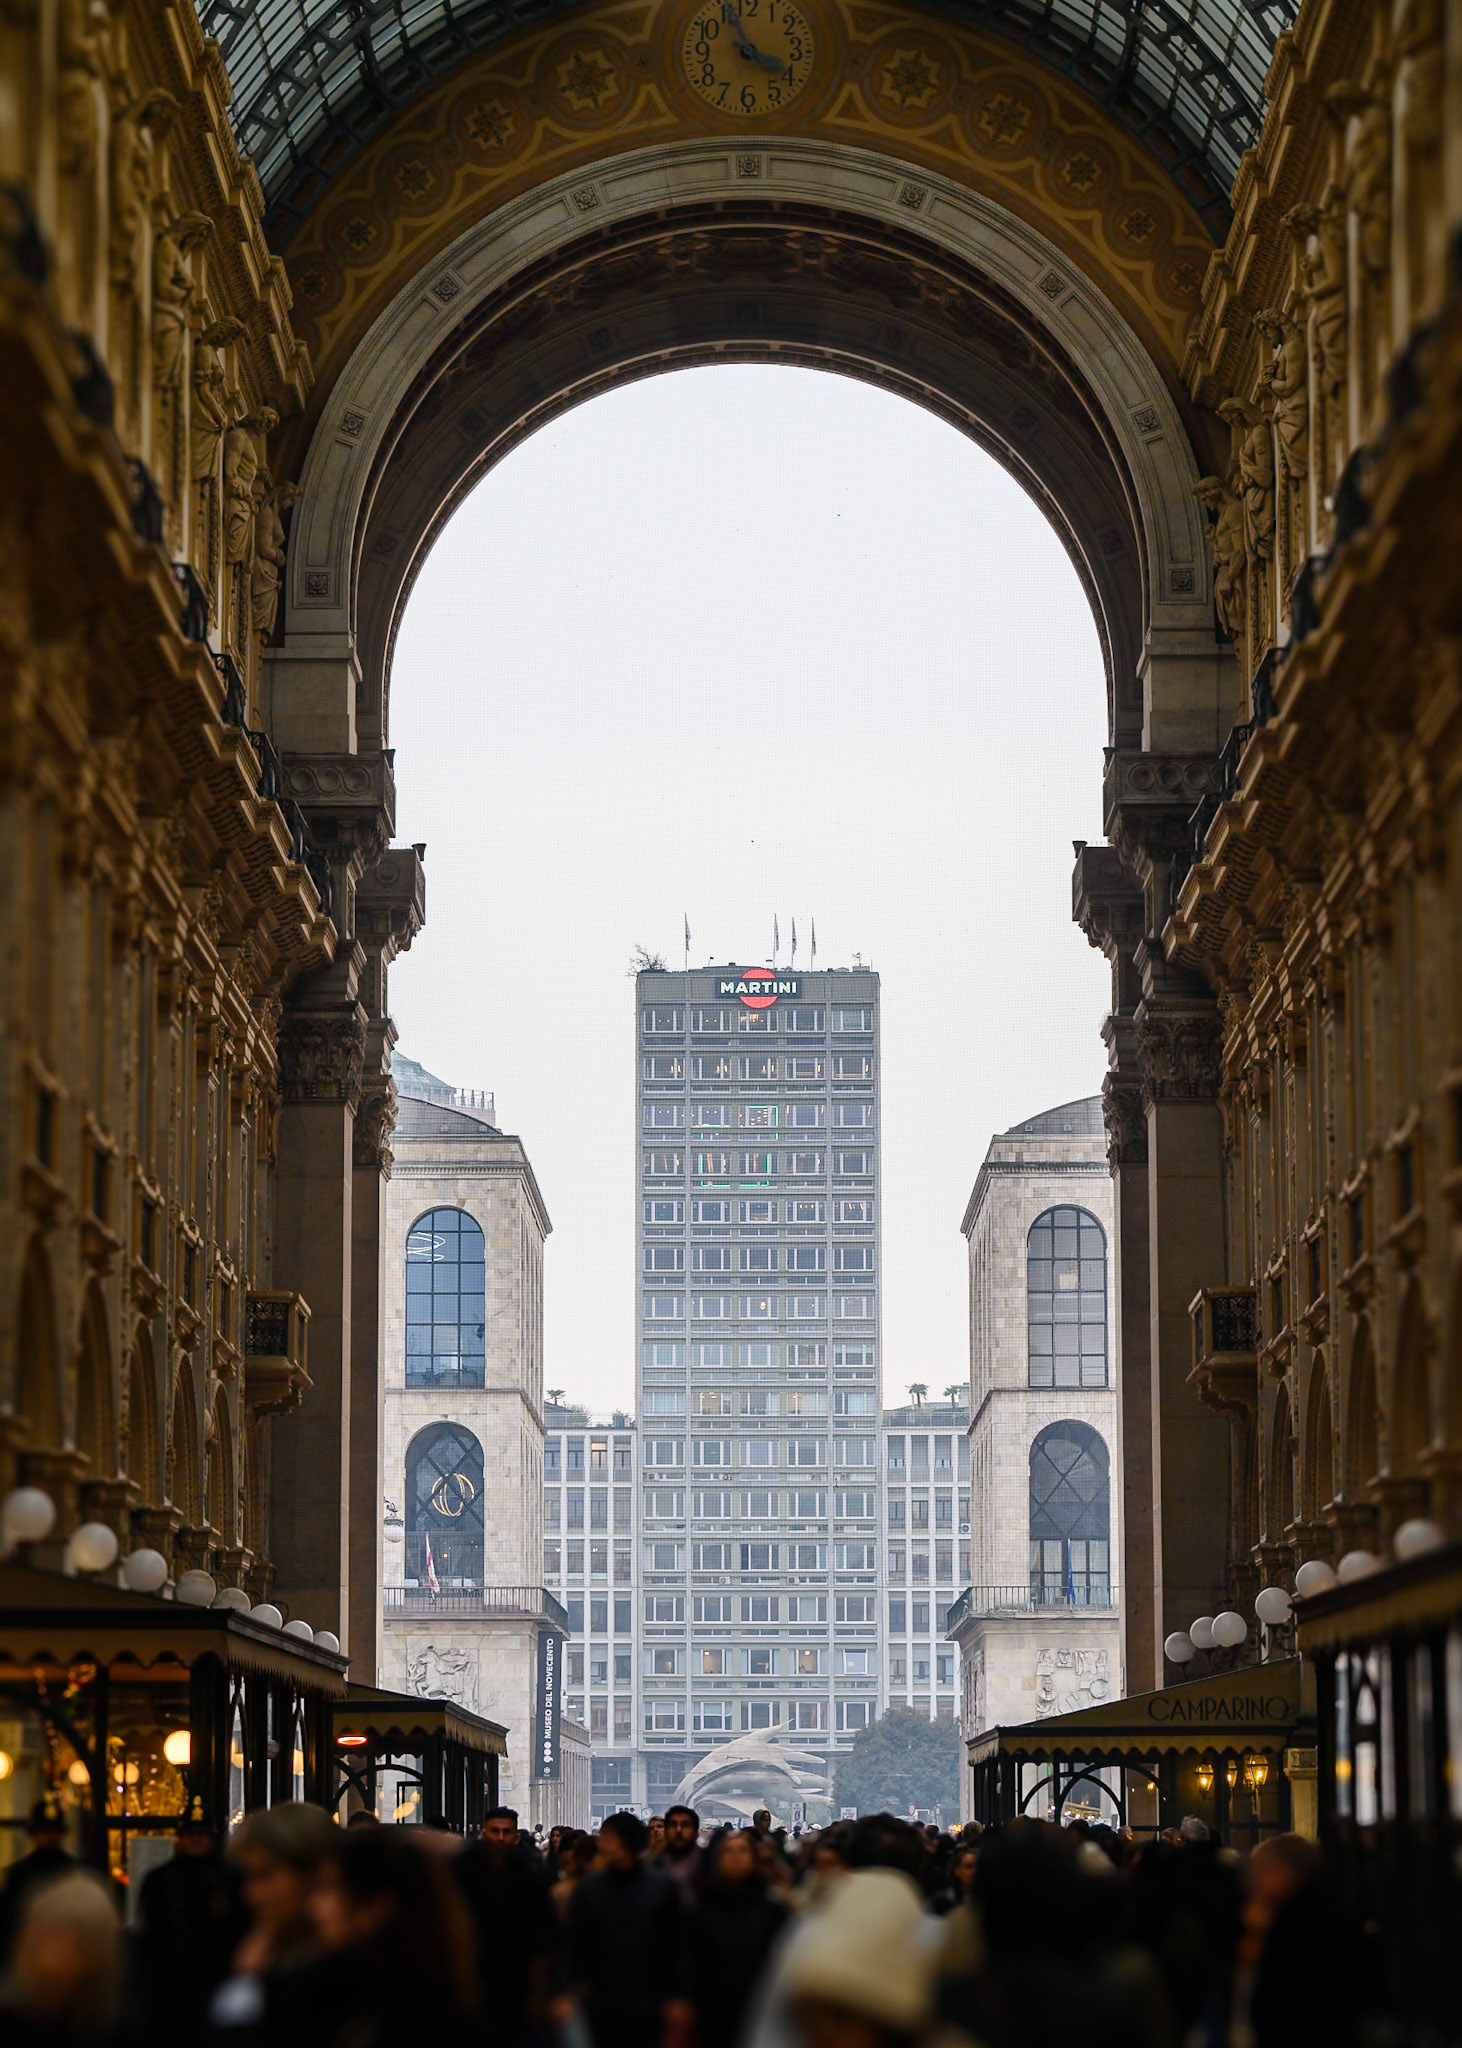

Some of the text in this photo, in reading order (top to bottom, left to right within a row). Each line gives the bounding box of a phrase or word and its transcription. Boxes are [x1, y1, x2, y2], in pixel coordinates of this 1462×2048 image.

[738, 0, 759, 17] 12
[768, 3, 775, 23] 1
[700, 18, 719, 41] 10
[782, 14, 796, 36] 2
[695, 41, 710, 64] 9
[789, 36, 803, 62] 3
[701, 63, 715, 87] 8
[781, 65, 796, 87] 4
[719, 82, 731, 101] 7
[740, 85, 756, 108] 6
[768, 80, 781, 101] 5
[720, 981, 797, 994] MARTINI
[545, 1637, 554, 1690] NOVECENTO
[545, 1691, 553, 1708] DEL
[1147, 1696, 1290, 1722] CAMPARINO
[544, 1709, 553, 1739] MUSEO
